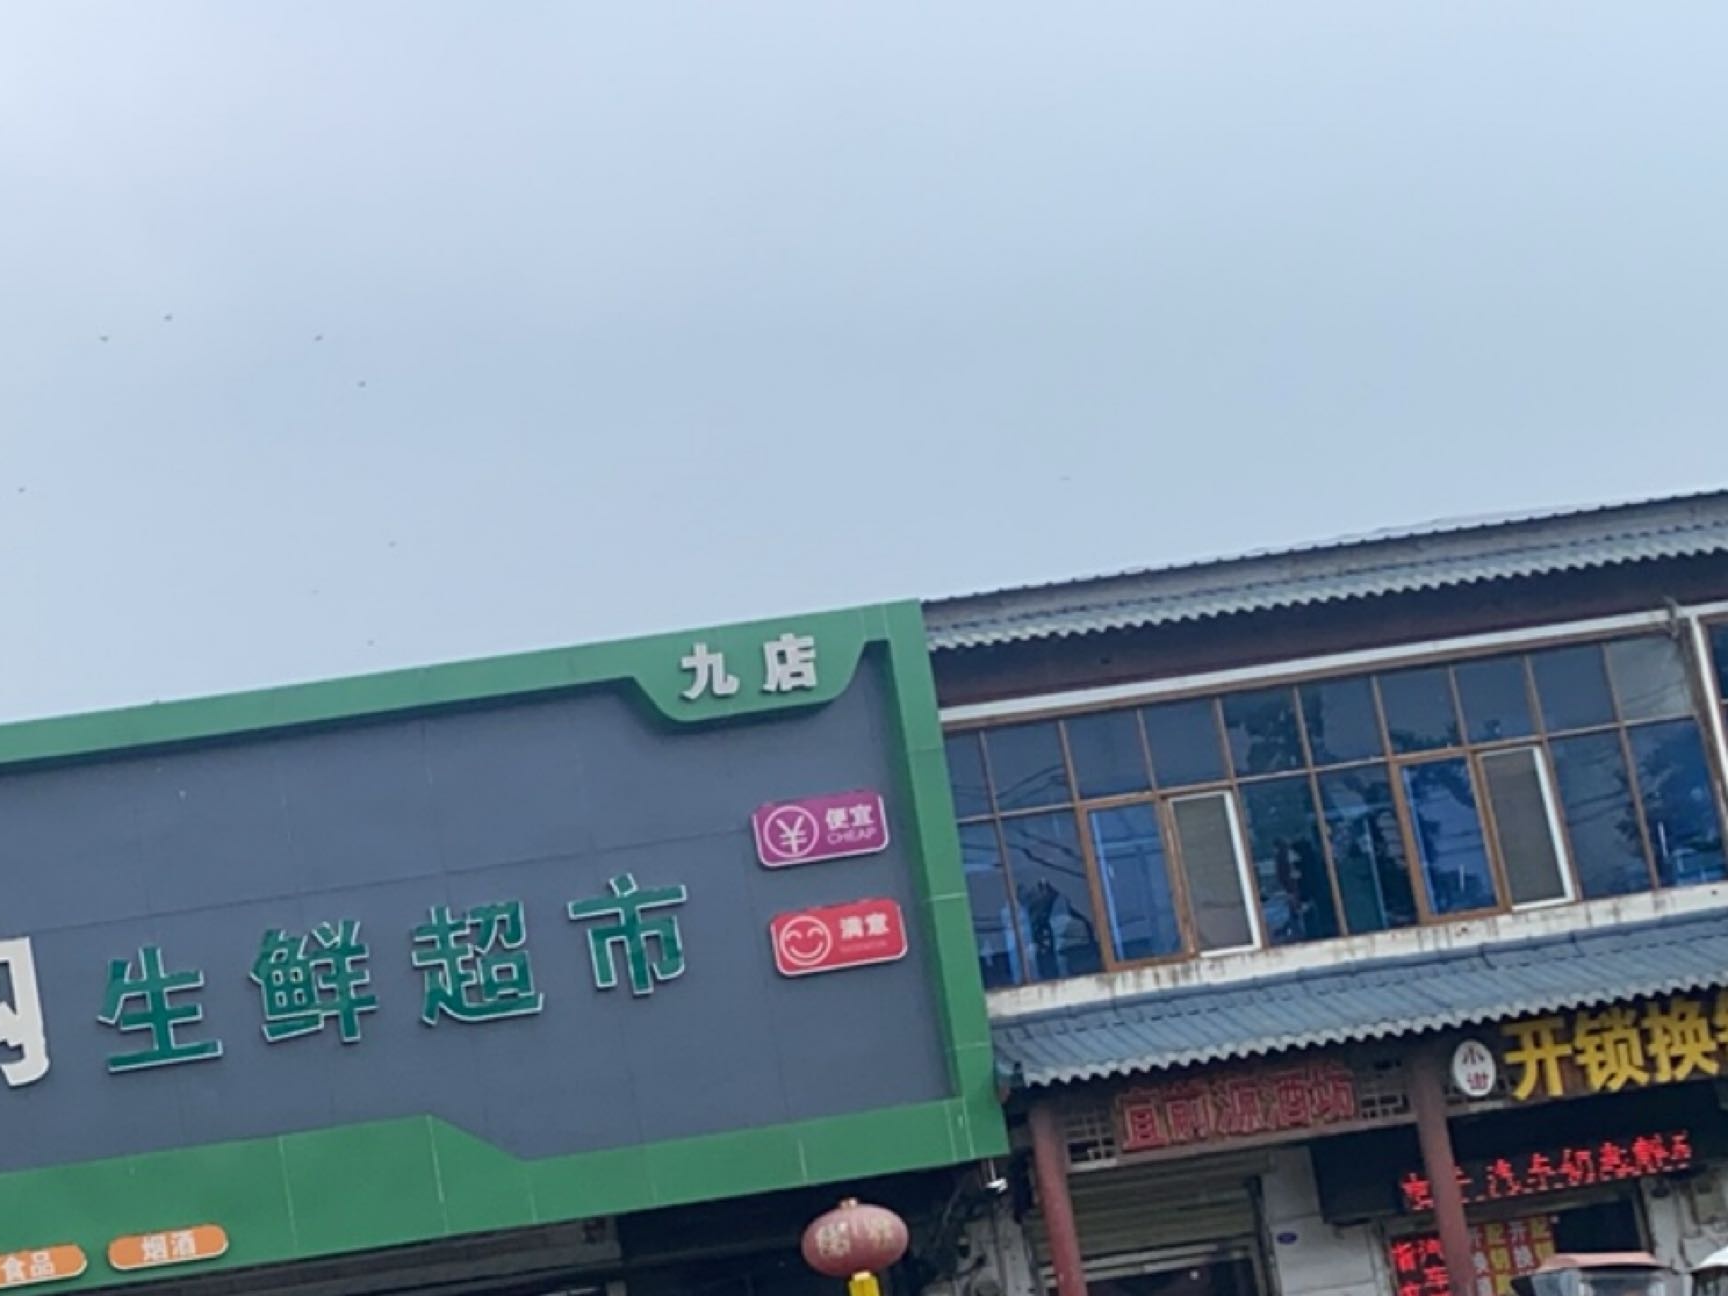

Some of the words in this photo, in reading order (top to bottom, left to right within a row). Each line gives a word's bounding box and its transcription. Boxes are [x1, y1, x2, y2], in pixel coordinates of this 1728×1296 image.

[681, 633, 819, 700] 九店
[825, 803, 874, 831] 便宜
[96, 873, 687, 1074] 生鲜超市
[1501, 993, 1728, 1101] 开锁换
[0, 1250, 56, 1284] 食品
[140, 1228, 197, 1262] 烟酒
